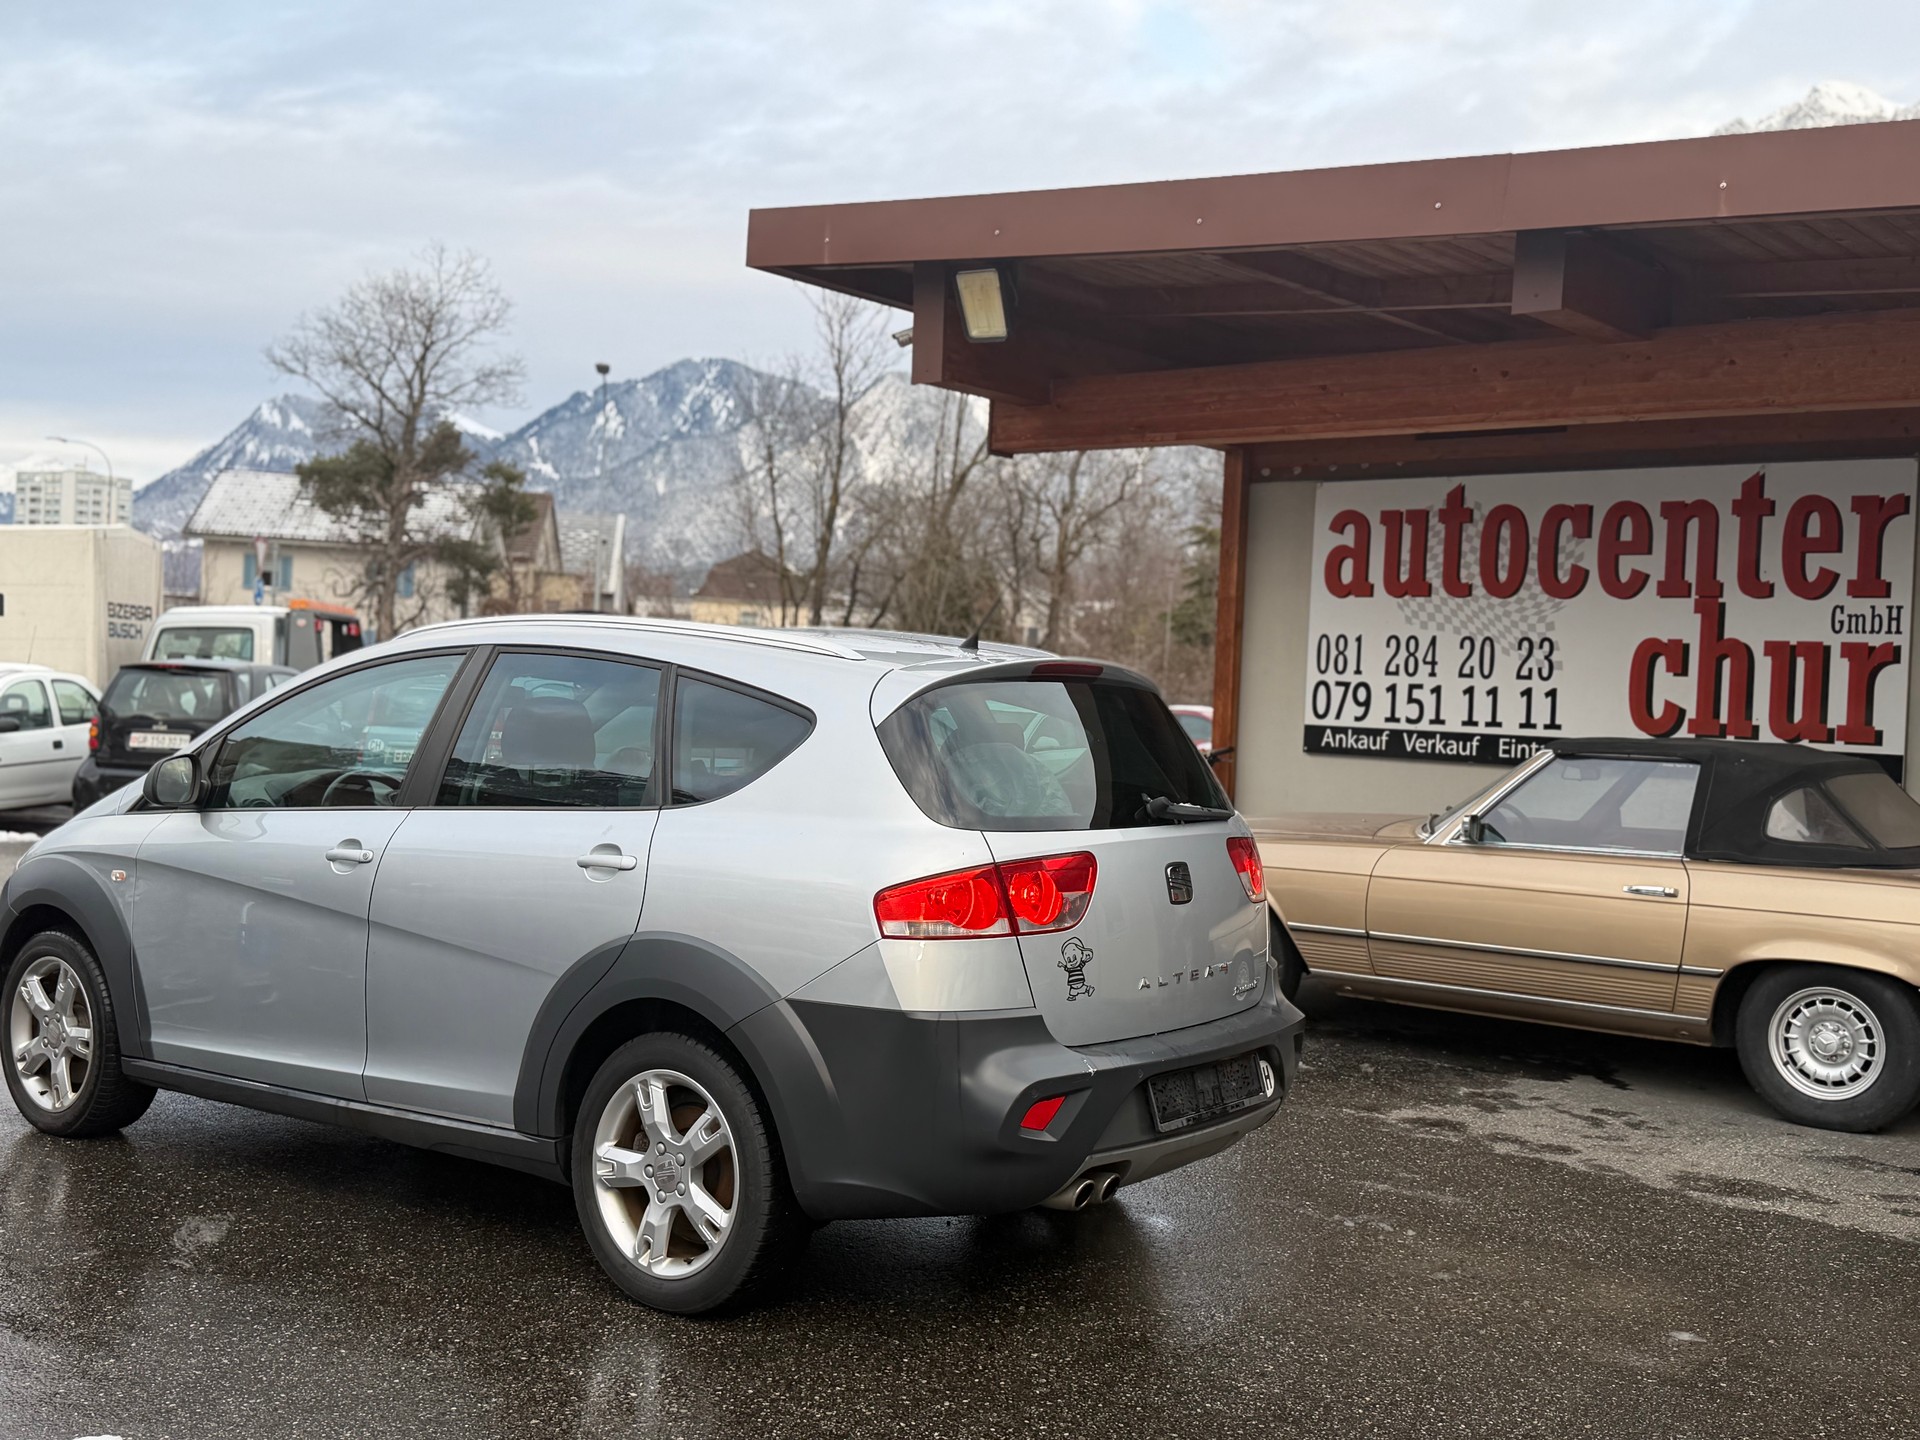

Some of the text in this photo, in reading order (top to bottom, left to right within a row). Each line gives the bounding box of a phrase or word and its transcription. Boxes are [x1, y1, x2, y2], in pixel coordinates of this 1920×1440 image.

[1324, 471, 1910, 600] autocenter
[1831, 605, 1904, 635] GmbH
[1316, 633, 1555, 682] 081 284 20 23
[1628, 597, 1902, 747] chur
[1311, 679, 1562, 731] 079 151 11 11
[1320, 728, 1391, 751] Ankauf
[1402, 732, 1481, 756] Verkauf
[1138, 965, 1214, 990] ALTEA
